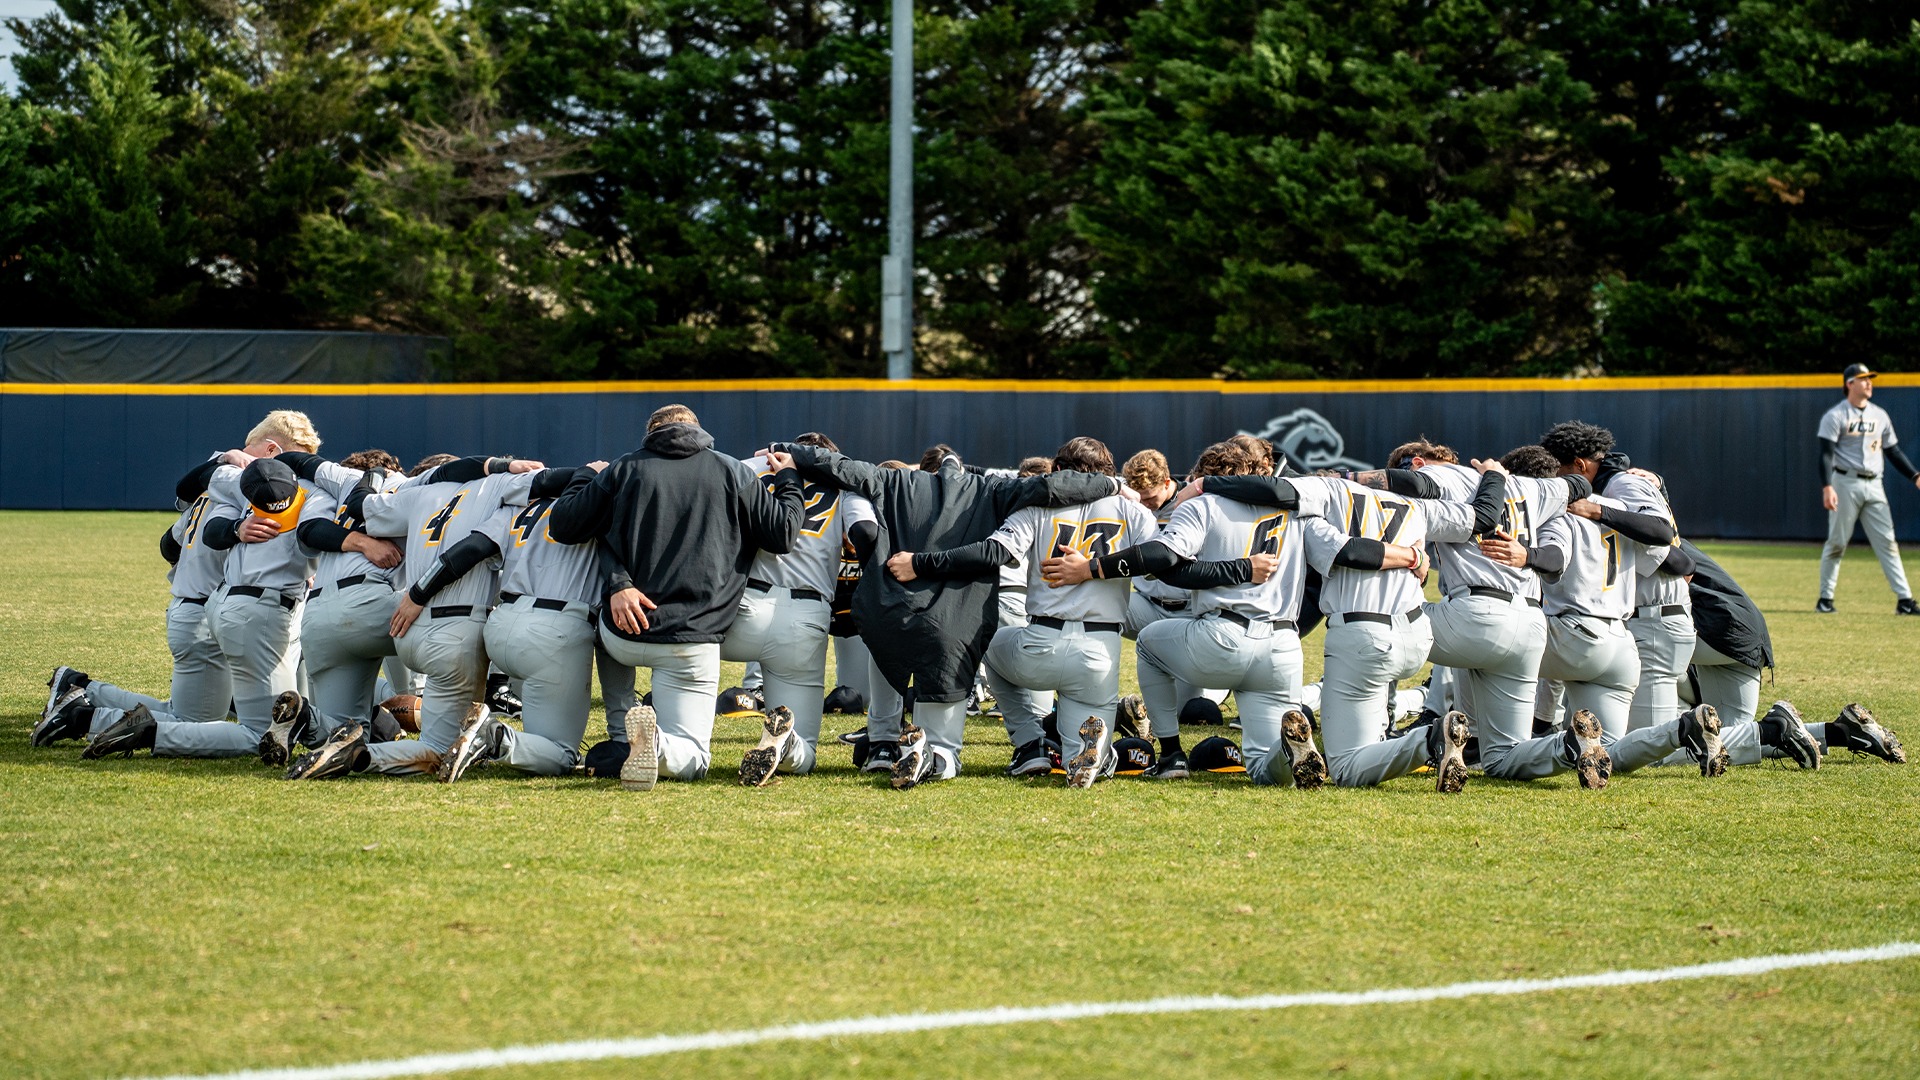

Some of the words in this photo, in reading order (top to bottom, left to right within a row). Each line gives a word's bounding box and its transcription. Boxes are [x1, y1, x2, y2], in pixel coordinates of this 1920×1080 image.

[1846, 420, 1877, 436] VCU
[266, 496, 291, 511] VCU
[420, 489, 468, 548] 4
[1345, 487, 1414, 545] 17
[510, 498, 559, 548] 4
[1243, 509, 1288, 559] 6
[1601, 529, 1621, 592] 1
[736, 694, 754, 710] VCU
[1128, 749, 1150, 767] VCU
[1224, 747, 1242, 764] VCU
